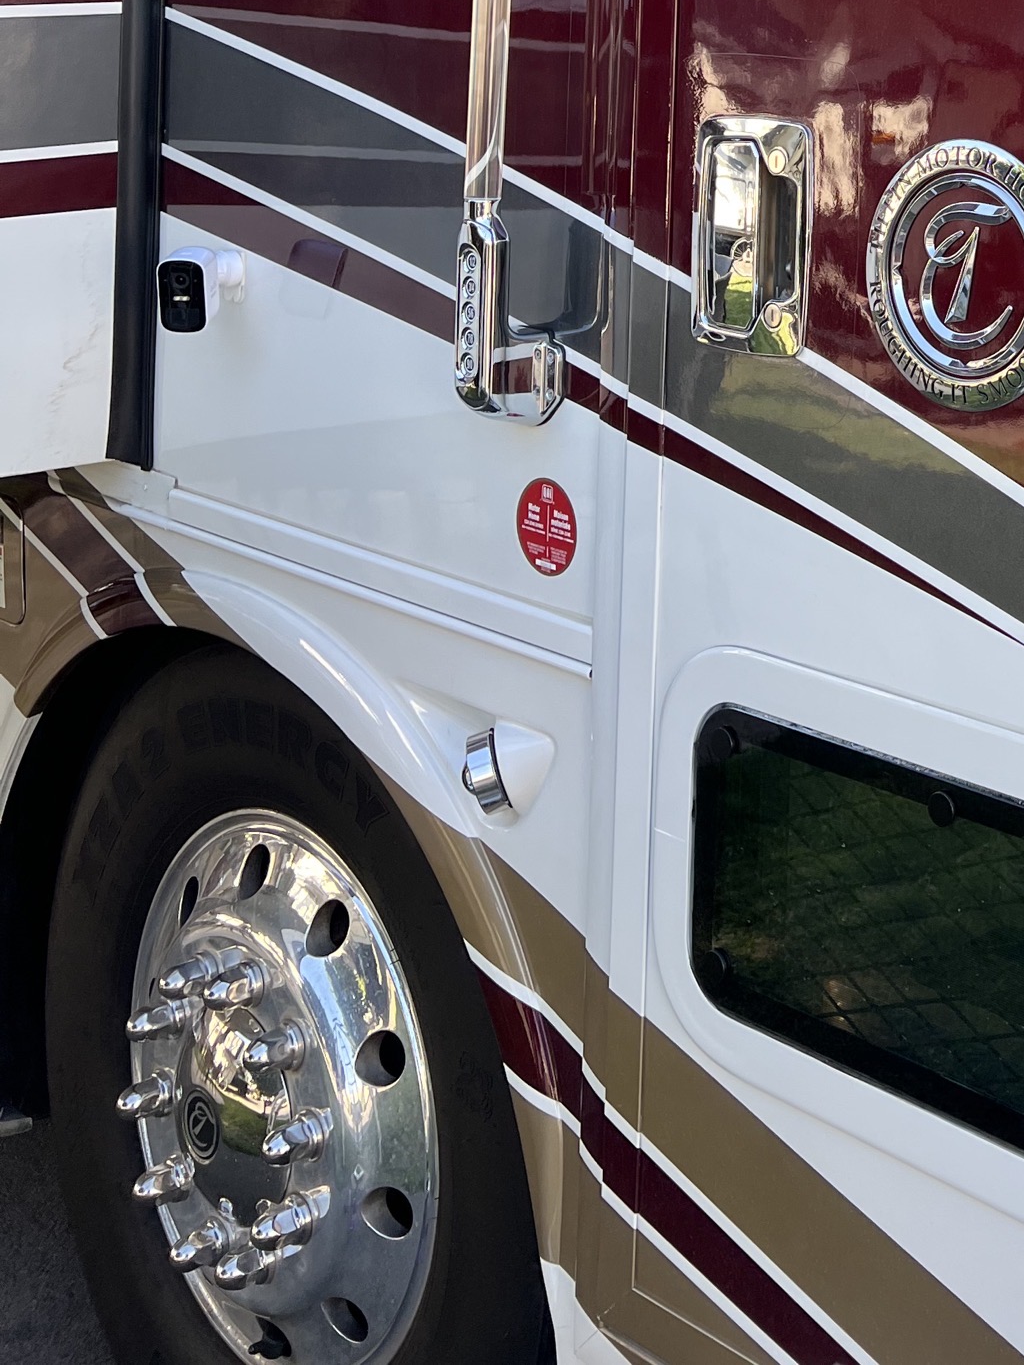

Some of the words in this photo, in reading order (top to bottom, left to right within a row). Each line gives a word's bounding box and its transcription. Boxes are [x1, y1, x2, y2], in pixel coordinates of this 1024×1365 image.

[915, 145, 998, 178] MOTOR
[869, 280, 944, 400] ROUGHING
[950, 385, 969, 405] IT
